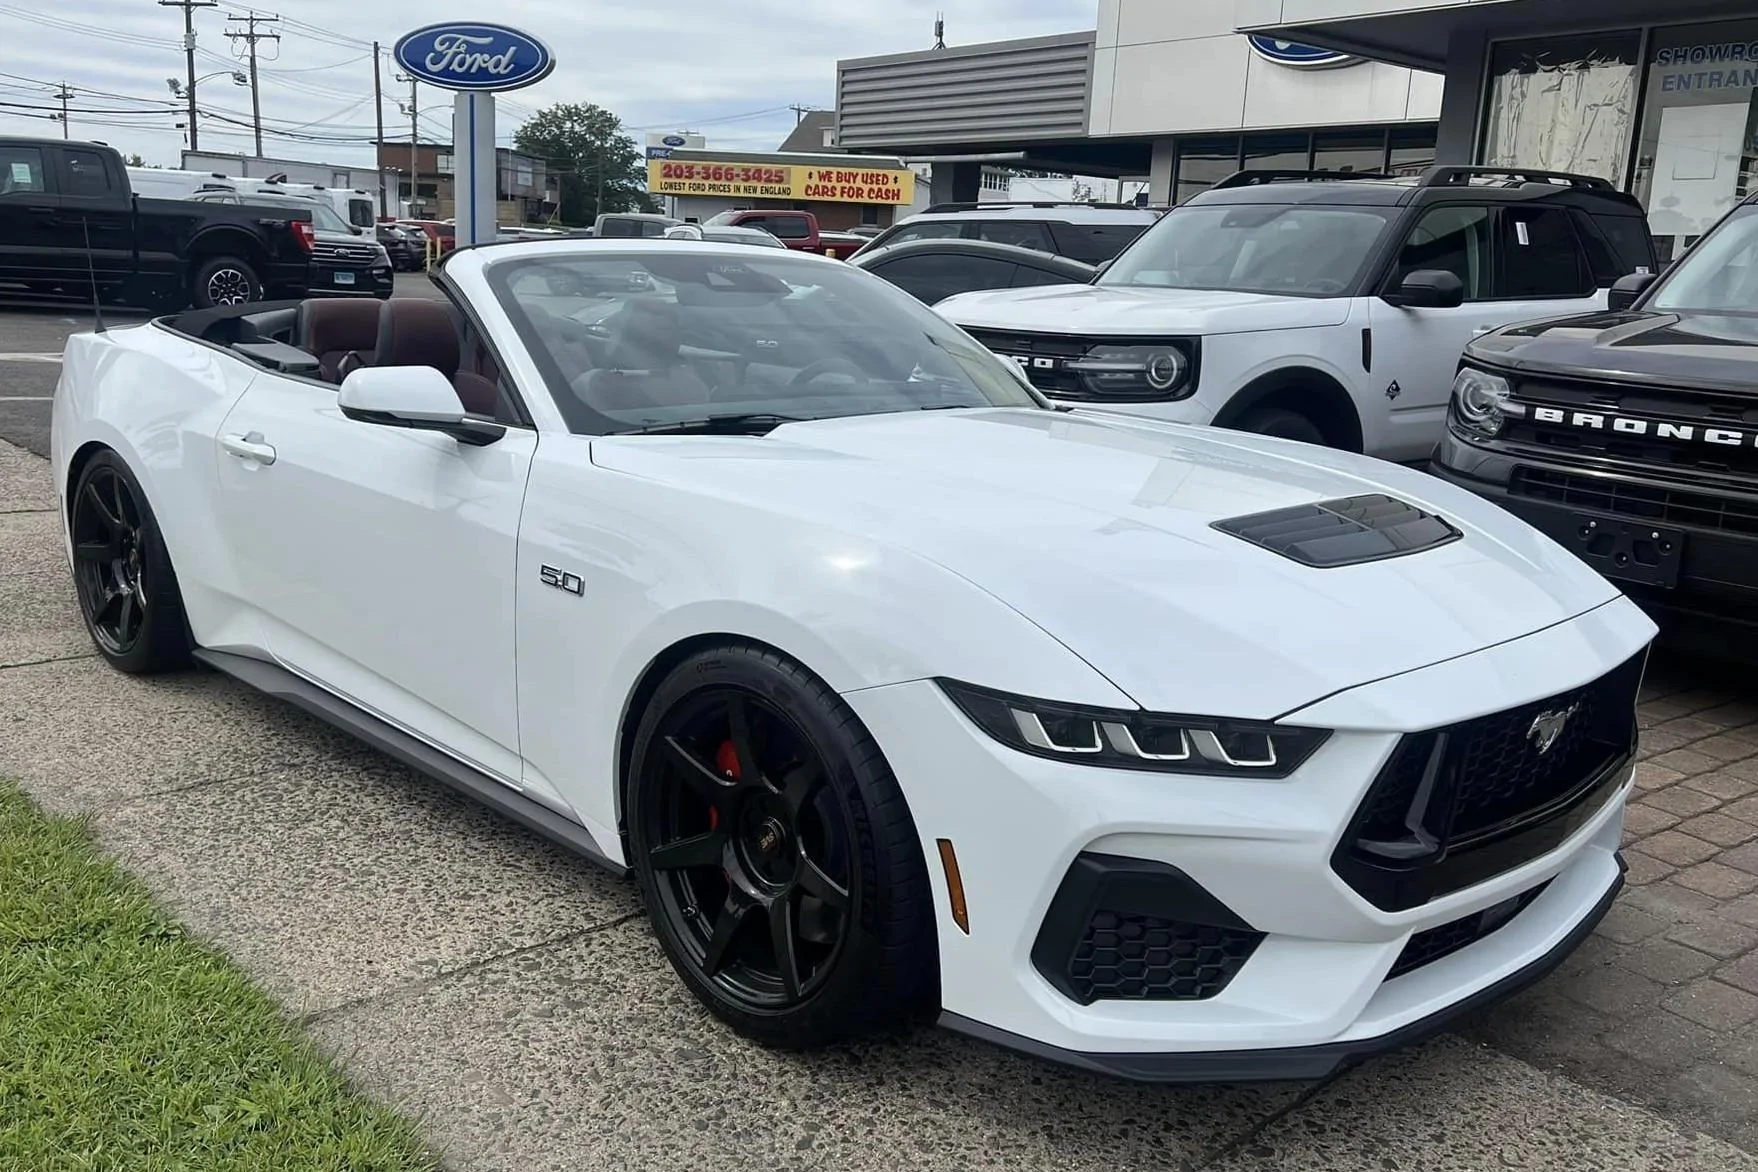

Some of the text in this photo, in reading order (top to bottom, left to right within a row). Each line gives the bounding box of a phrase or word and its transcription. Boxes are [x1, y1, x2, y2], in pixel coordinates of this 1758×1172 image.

[424, 33, 517, 75] Ford
[662, 163, 784, 184] 203-366-3425
[818, 170, 833, 183] WE
[836, 171, 858, 184] BUY
[861, 173, 889, 186] USED
[660, 181, 791, 196] LOWEST FORD PRICES IN NEW ENGLAND
[805, 184, 900, 201] CARS FOR CASH
[1534, 406, 1758, 448] BRONC
